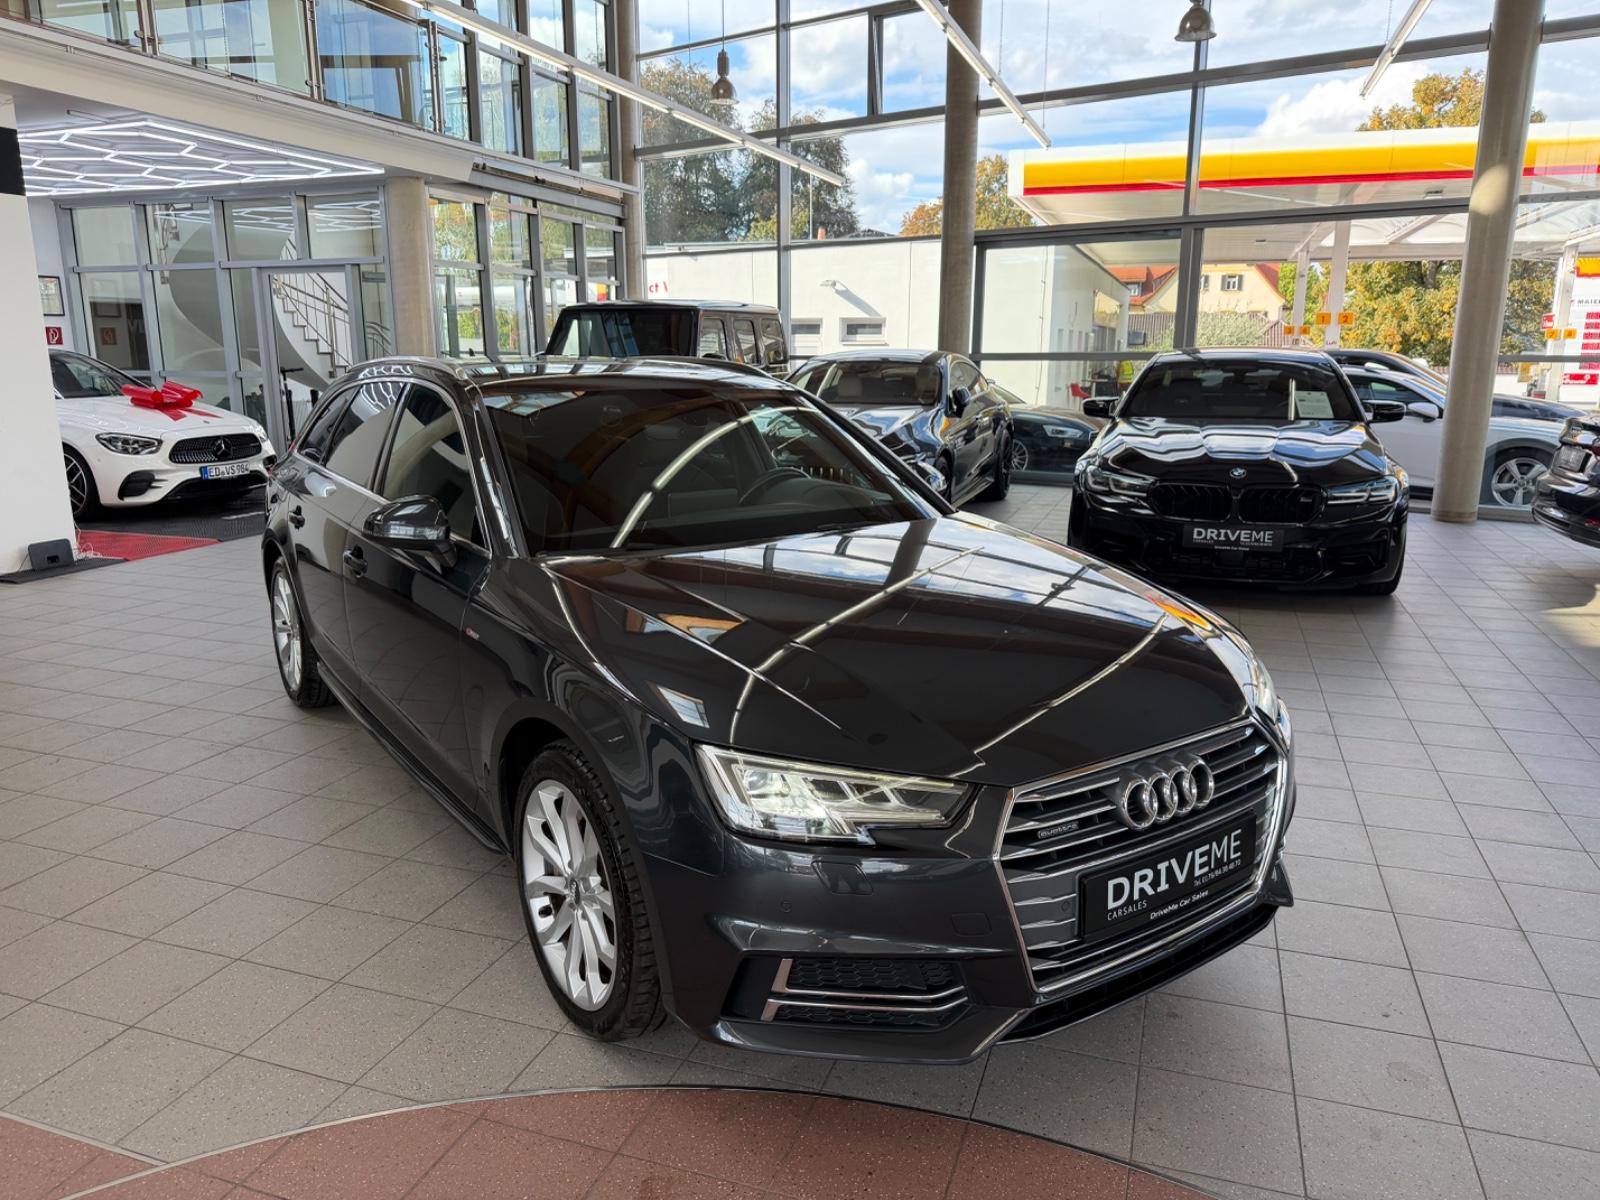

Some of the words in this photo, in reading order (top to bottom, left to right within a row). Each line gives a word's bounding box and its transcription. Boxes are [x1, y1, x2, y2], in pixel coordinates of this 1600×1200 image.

[1193, 527, 1274, 543] DRIVEME
[1107, 828, 1242, 911] DRIVEME
[1107, 900, 1148, 921] CARSALES
